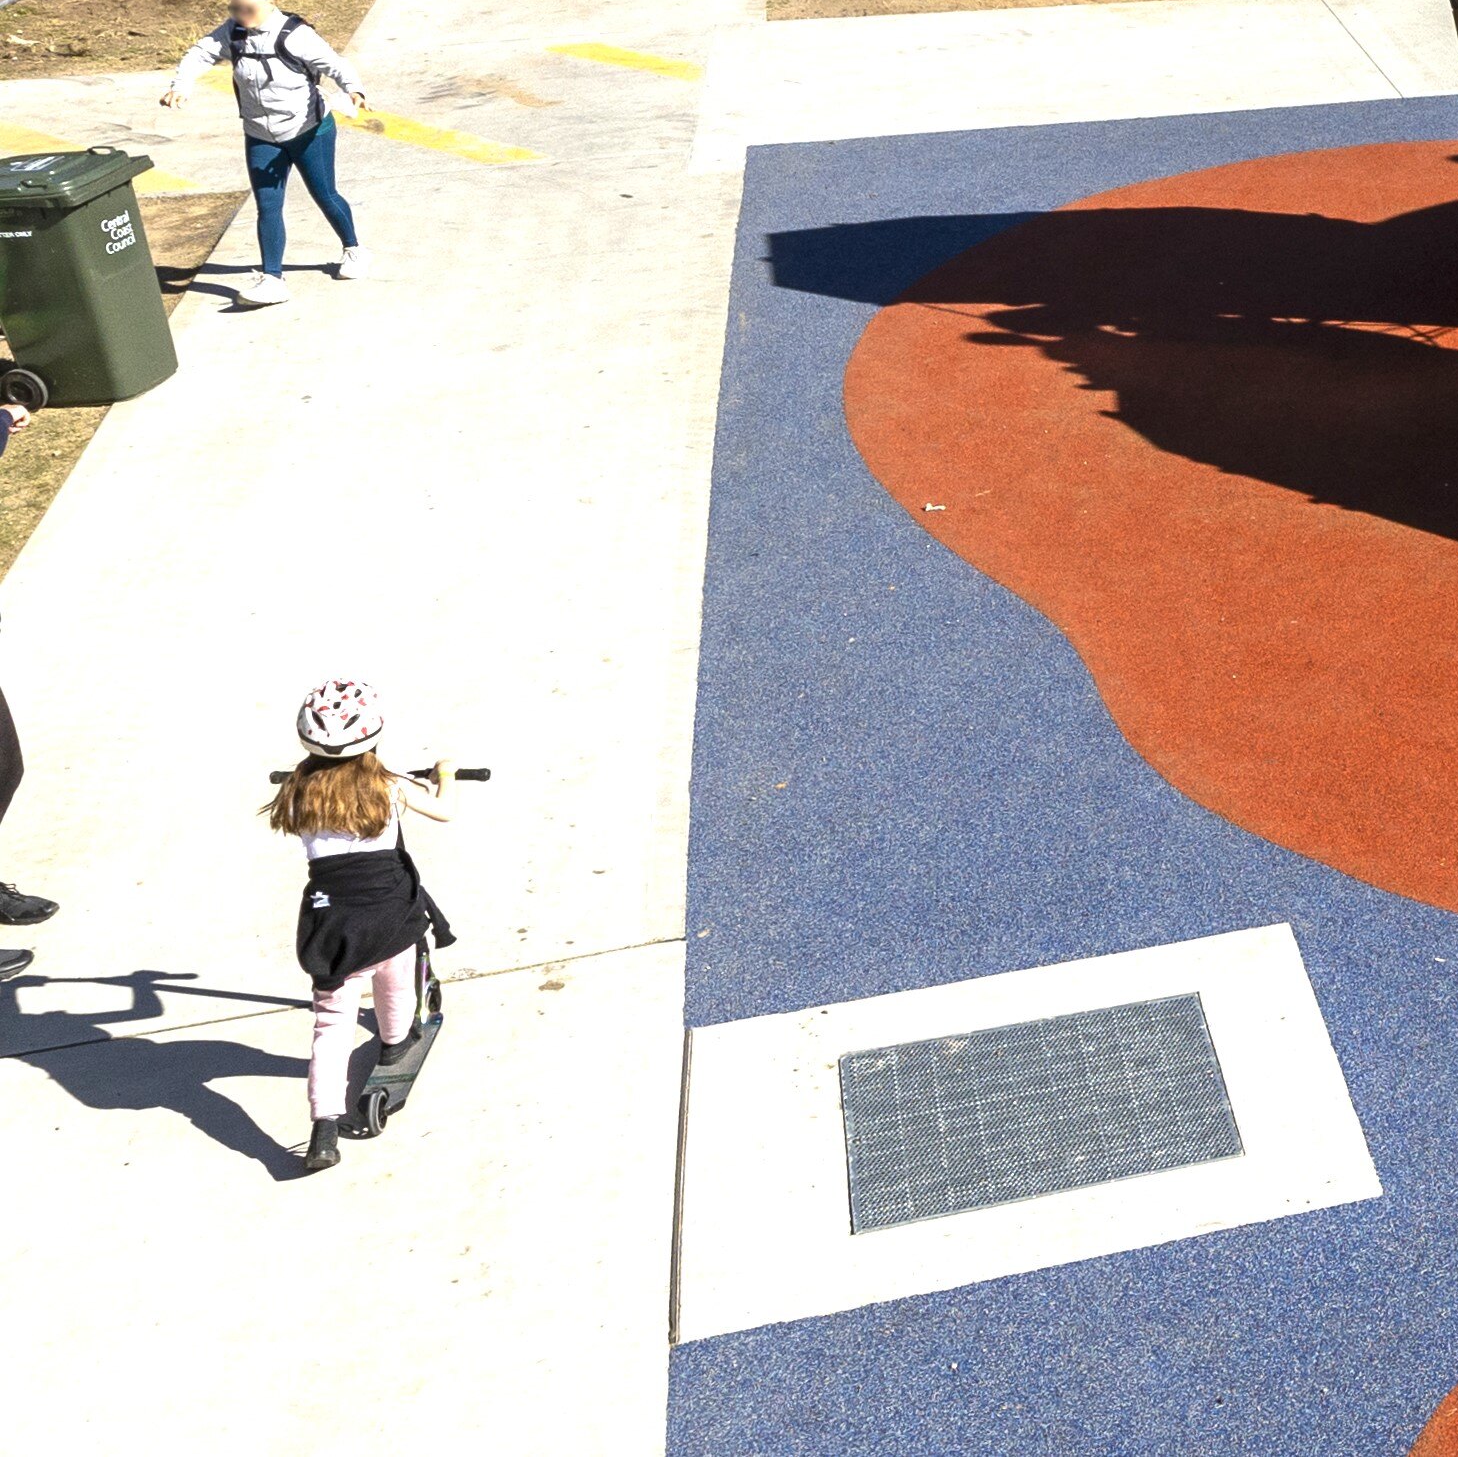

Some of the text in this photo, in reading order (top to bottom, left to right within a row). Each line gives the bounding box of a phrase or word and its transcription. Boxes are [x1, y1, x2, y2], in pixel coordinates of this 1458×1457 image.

[101, 209, 130, 232] Central
[110, 222, 134, 240] Coast
[105, 232, 136, 255] Council
